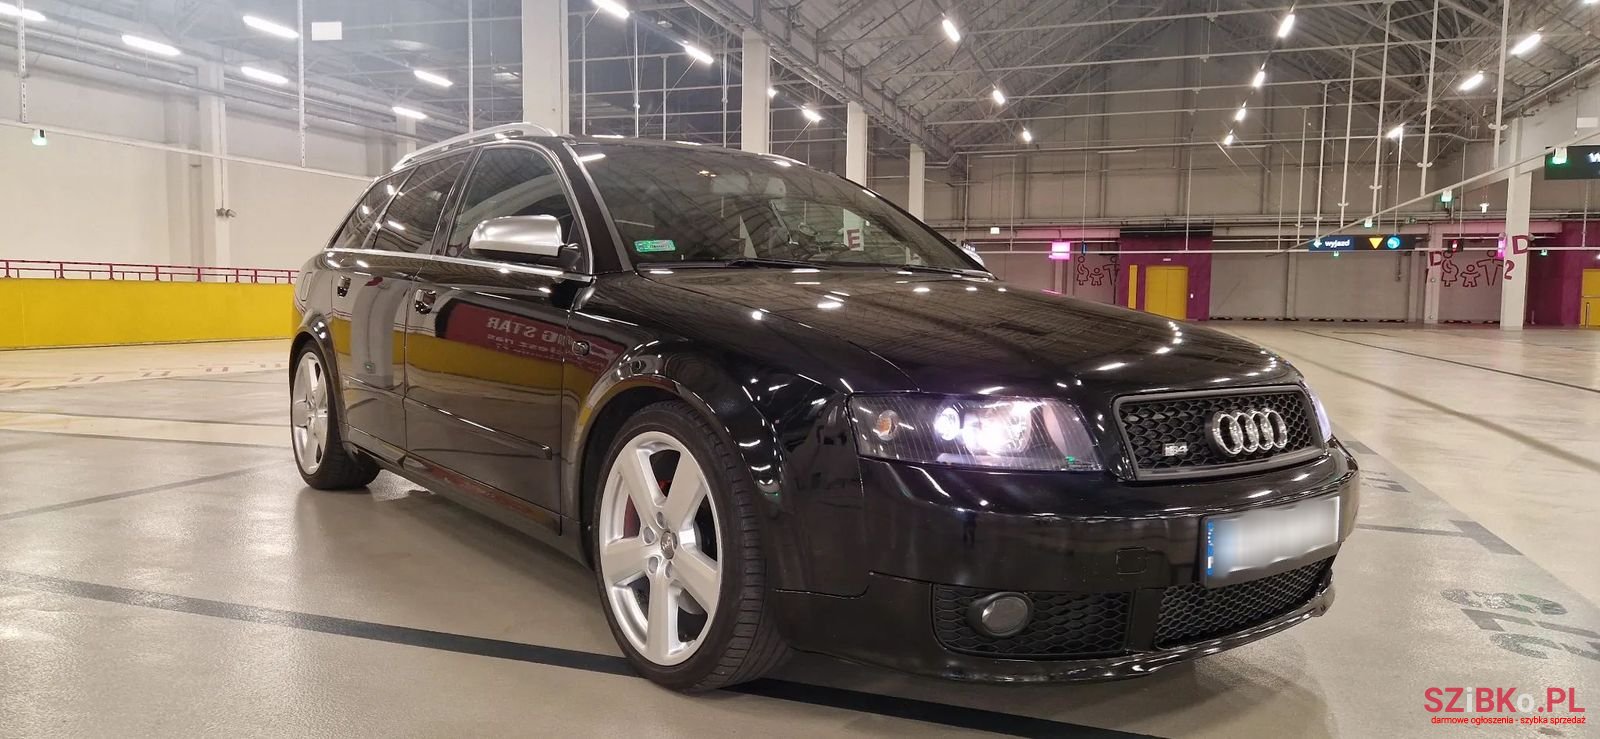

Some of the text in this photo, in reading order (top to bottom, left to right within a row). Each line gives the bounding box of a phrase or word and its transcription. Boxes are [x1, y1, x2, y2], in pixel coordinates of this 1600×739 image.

[847, 229, 861, 251] E
[1325, 239, 1350, 249] wyjazd
[1512, 235, 1529, 255] D
[1504, 260, 1515, 280] 2
